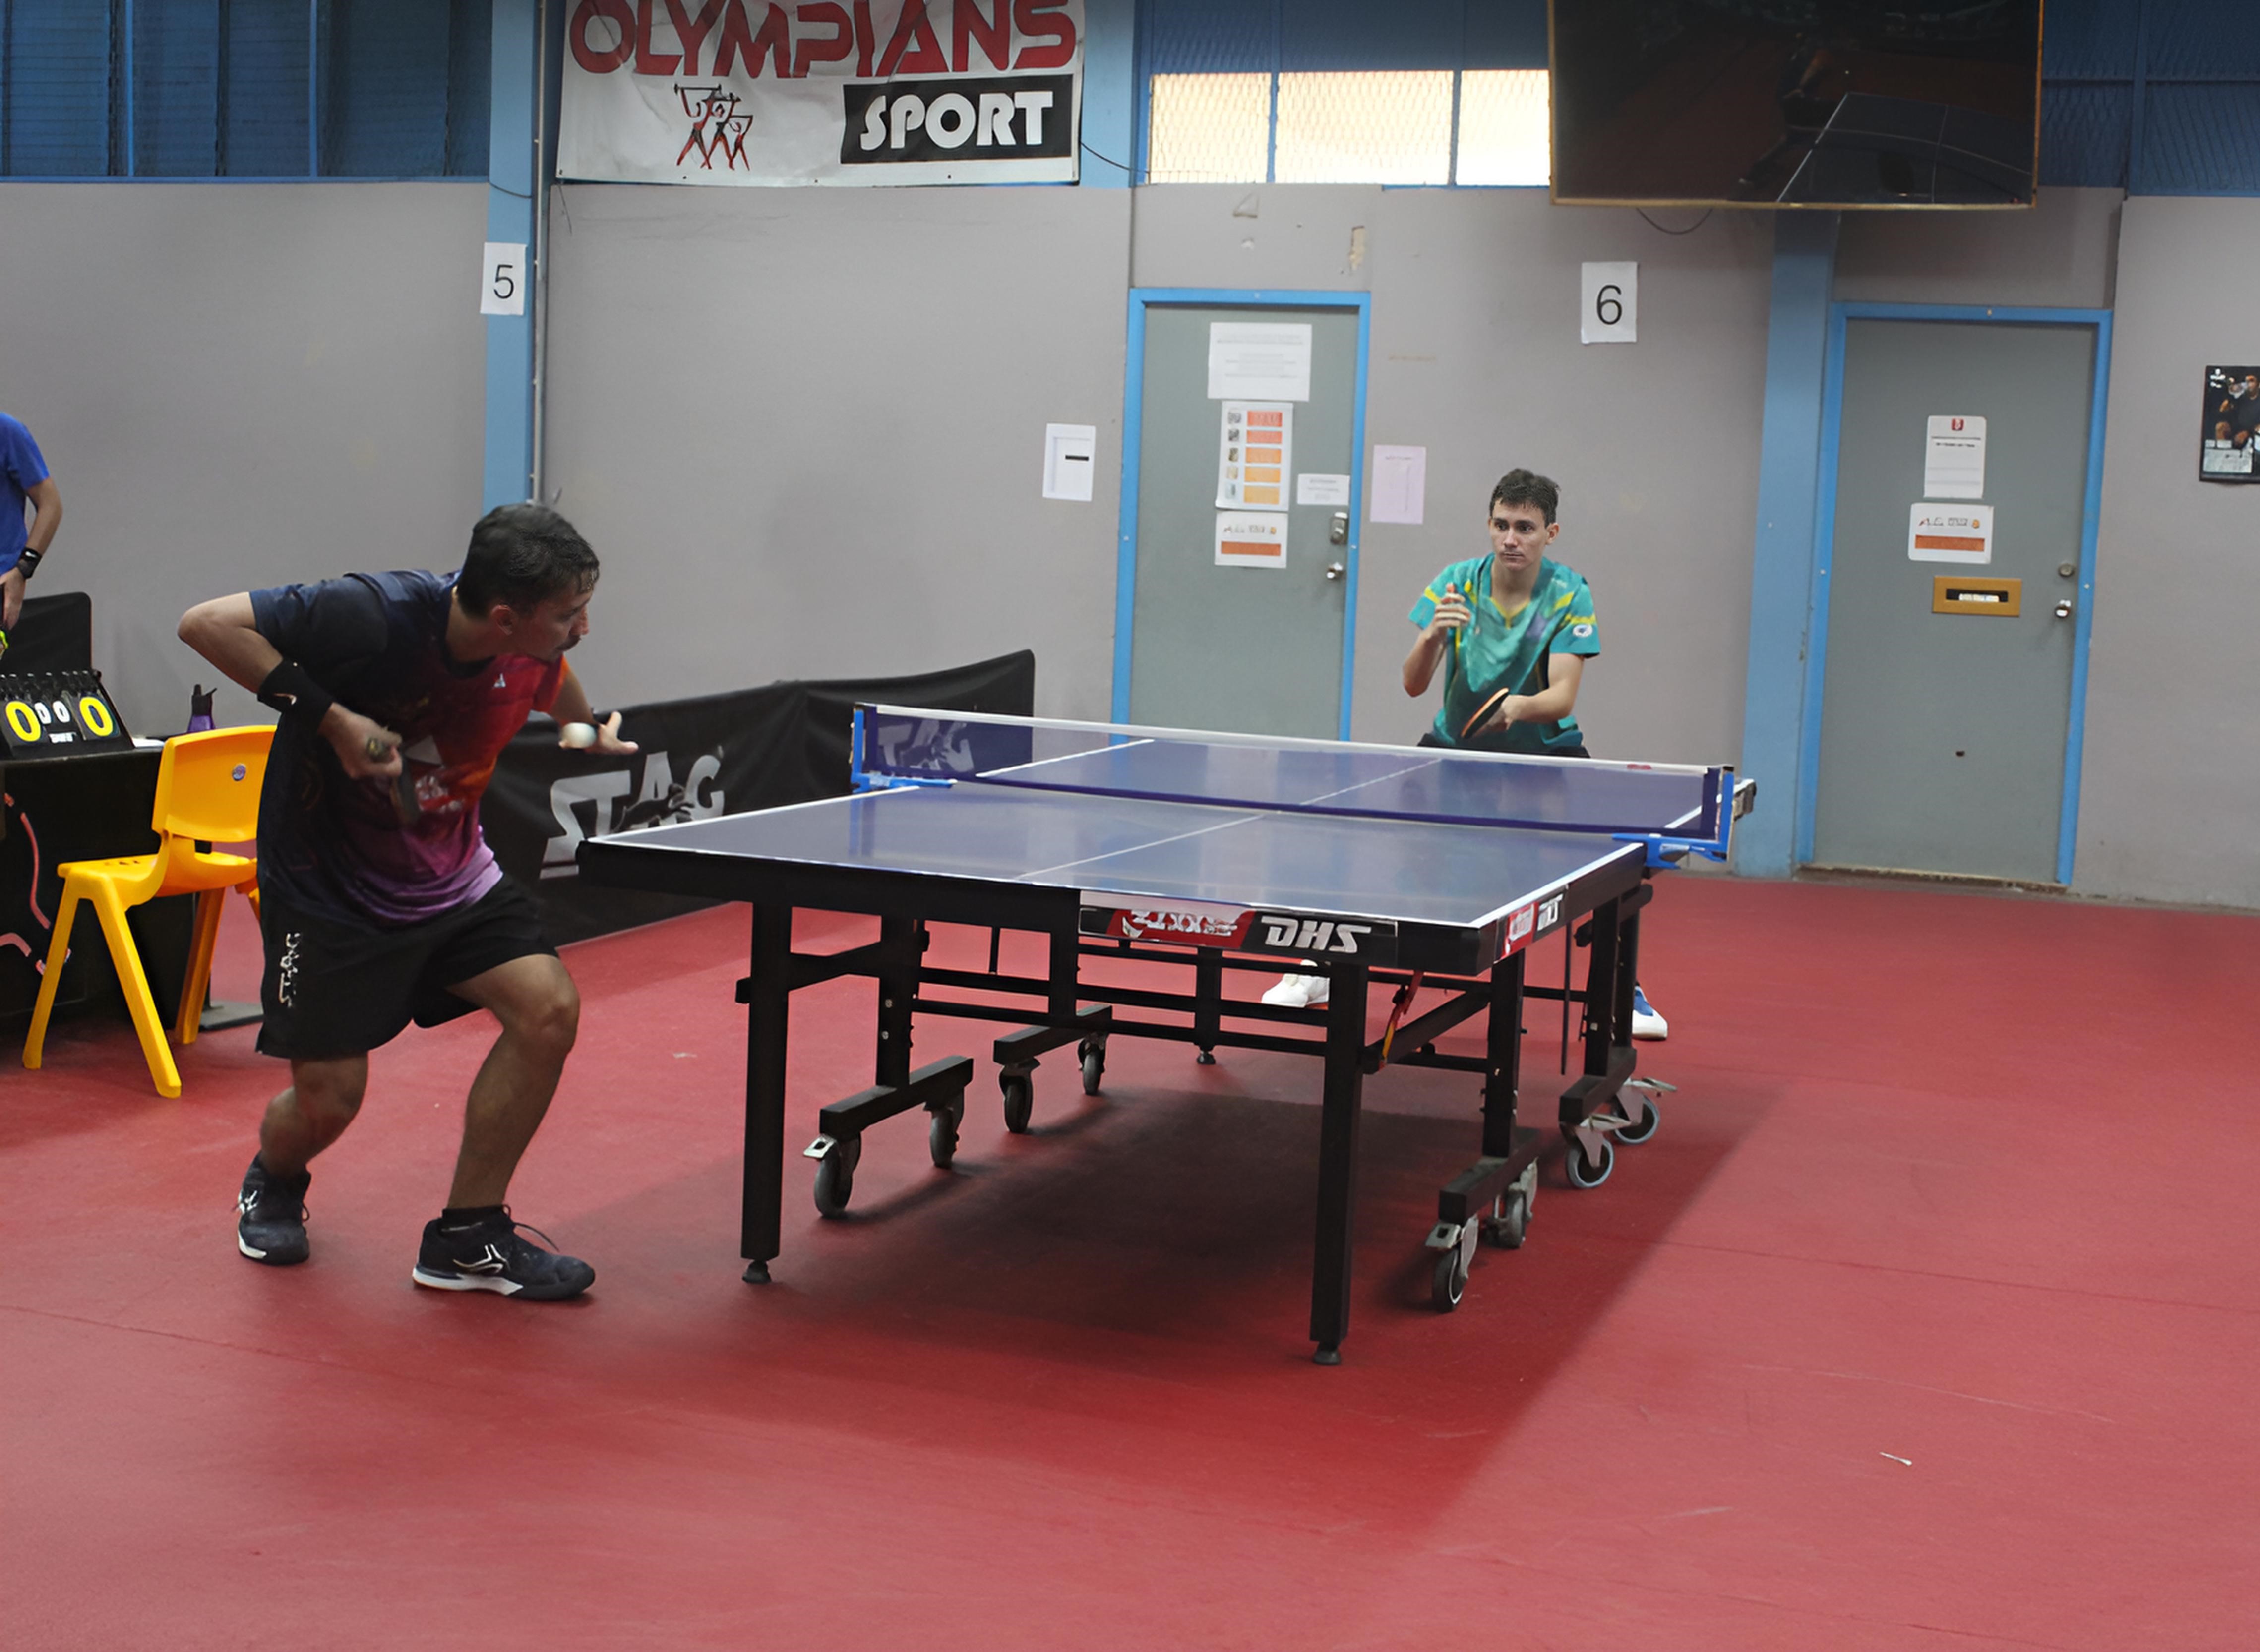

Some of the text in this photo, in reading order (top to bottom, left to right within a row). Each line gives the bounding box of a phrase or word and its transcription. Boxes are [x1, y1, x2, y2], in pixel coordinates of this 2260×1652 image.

[569, 0, 1076, 79] OLYMPIANS
[860, 91, 1054, 151] SPORT
[493, 264, 514, 299] 5
[1596, 284, 1623, 326] 6
[5, 700, 42, 742] 0
[52, 700, 71, 723] 0
[79, 696, 114, 737] 0
[541, 751, 725, 864] STAG
[1260, 915, 1372, 953] DHS
